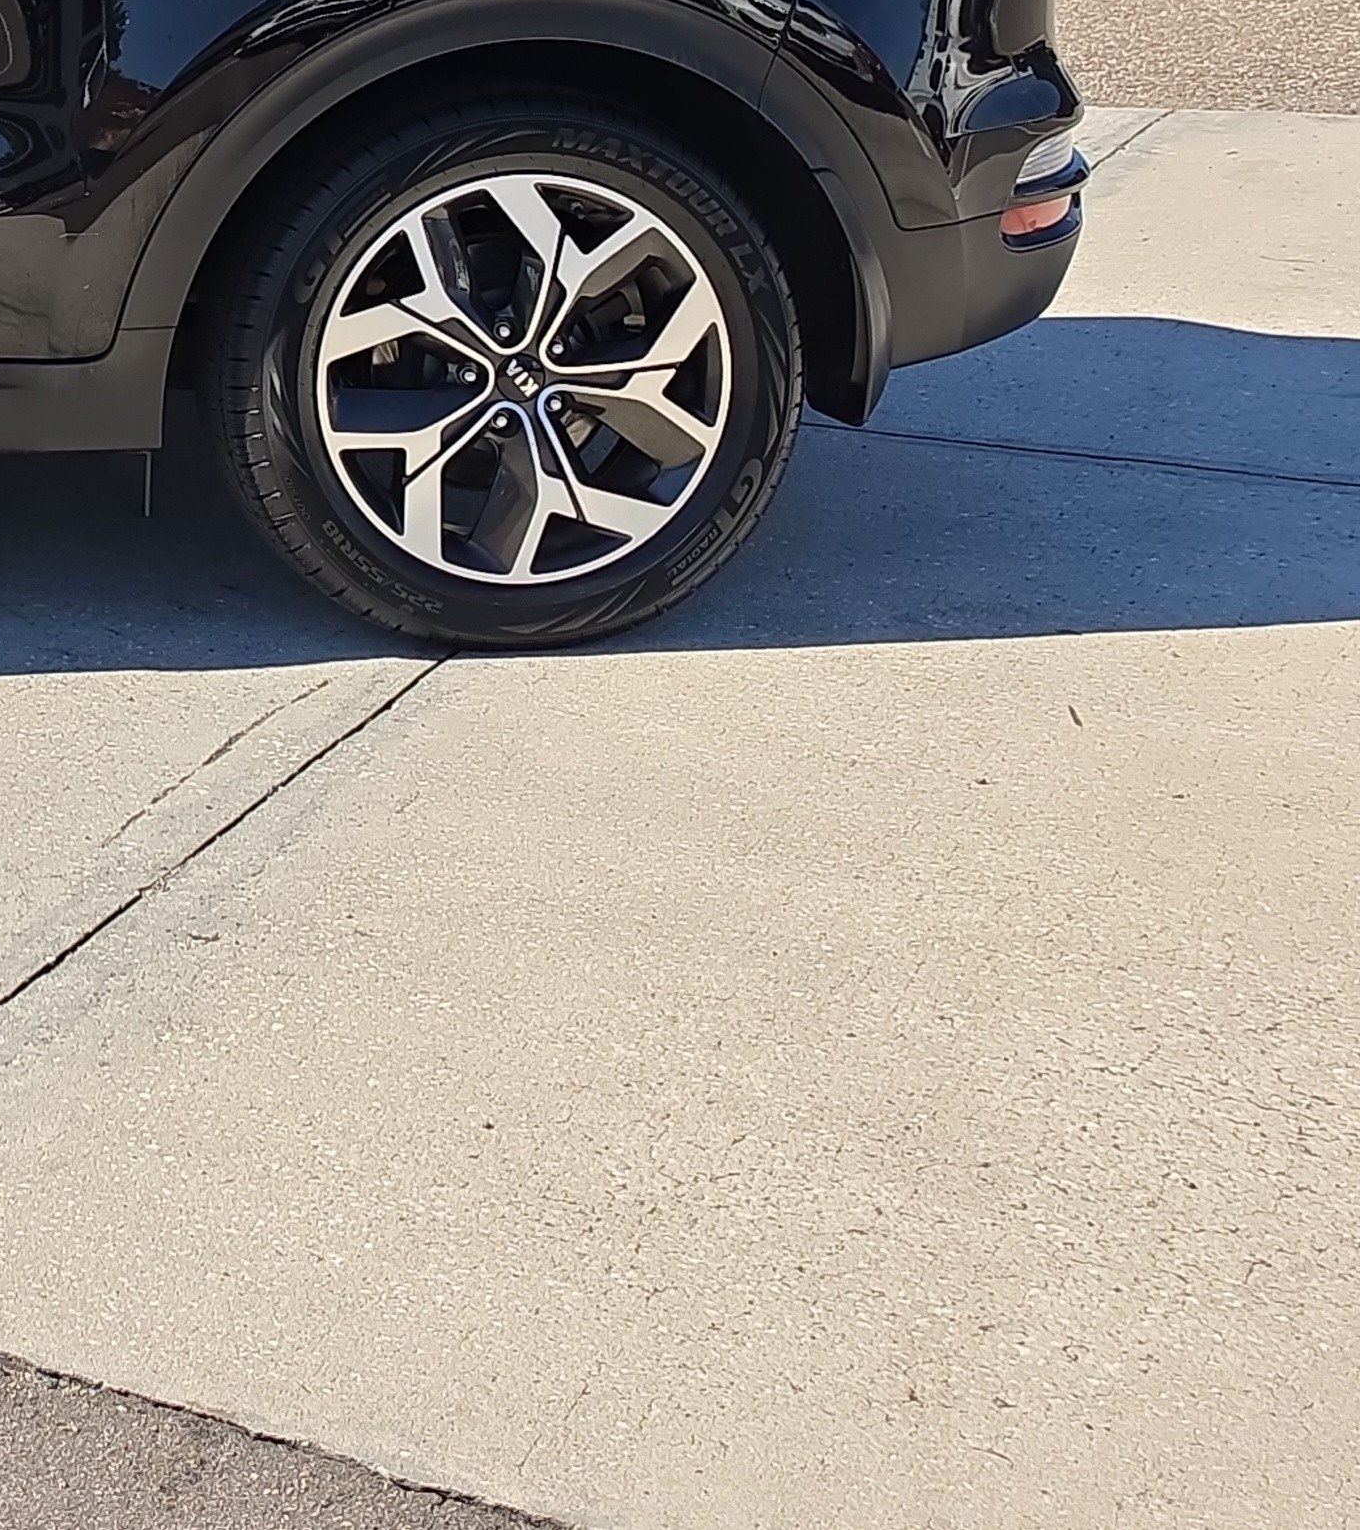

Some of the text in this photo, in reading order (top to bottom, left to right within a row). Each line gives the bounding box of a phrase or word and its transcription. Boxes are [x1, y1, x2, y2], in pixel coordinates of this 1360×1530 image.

[551, 127, 772, 296] MAXTOUR LX
[505, 358, 540, 398] KIA
[322, 520, 445, 614] 225/55R18
[666, 457, 763, 577] GT RADIAL
